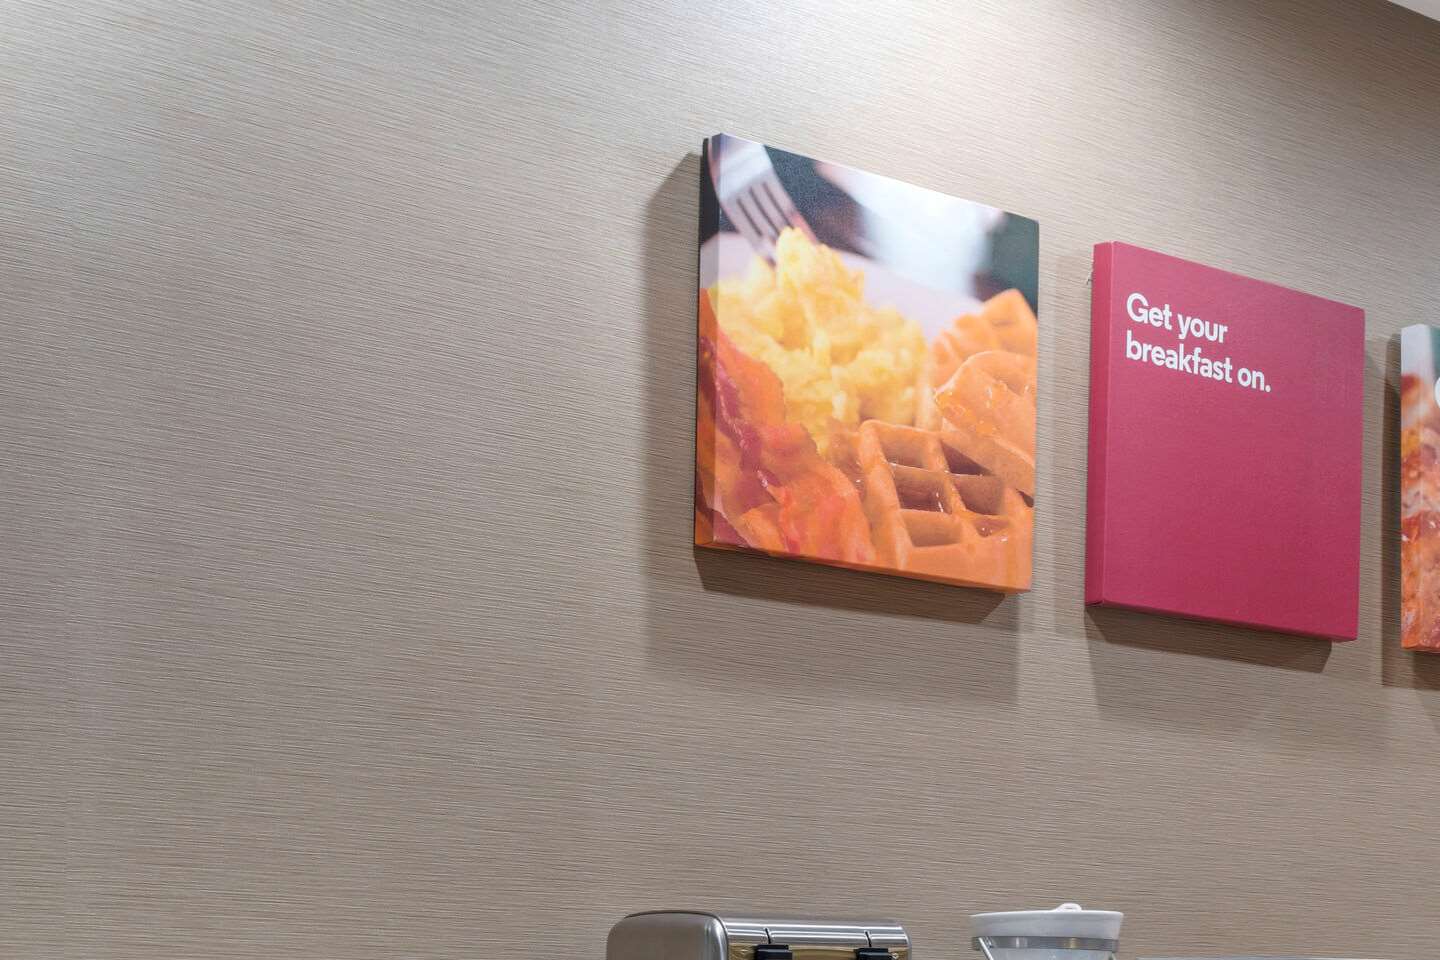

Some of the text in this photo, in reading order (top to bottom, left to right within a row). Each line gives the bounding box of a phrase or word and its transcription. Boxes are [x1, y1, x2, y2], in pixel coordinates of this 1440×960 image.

[1126, 292, 1228, 344] Get your
[1126, 330, 1272, 393] breakfast on.
